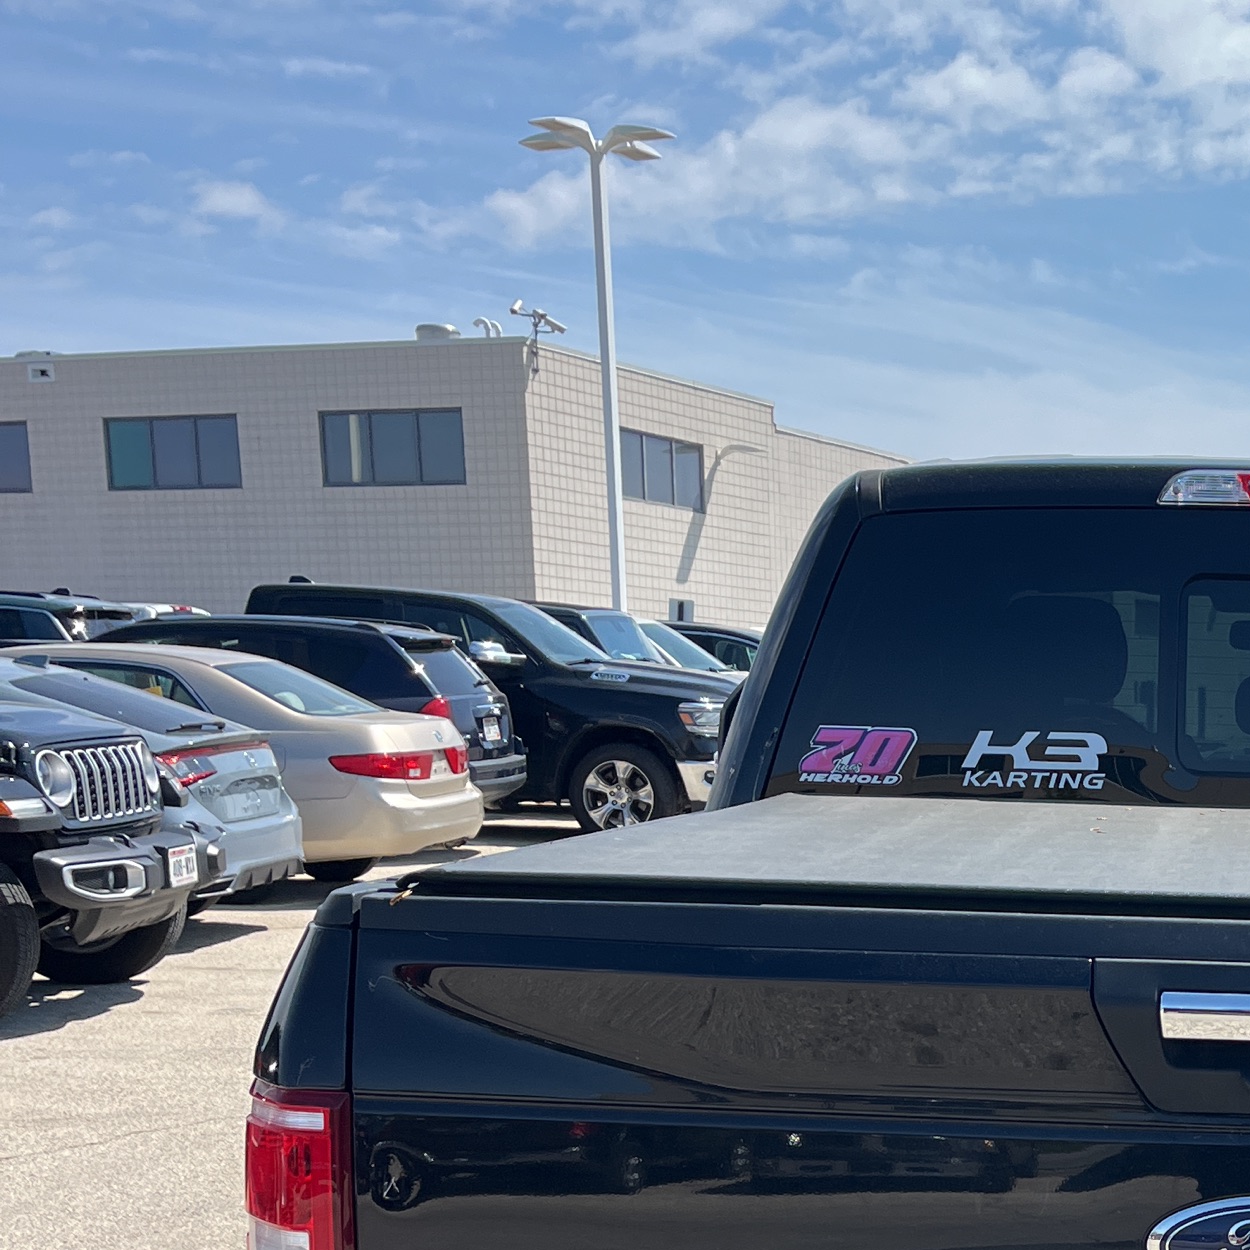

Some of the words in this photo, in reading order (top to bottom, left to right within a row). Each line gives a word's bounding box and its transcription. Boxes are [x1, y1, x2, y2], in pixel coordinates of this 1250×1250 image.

[961, 730, 1108, 770] K3
[799, 773, 900, 785] HERHOLD
[962, 770, 1106, 790] KARTING
